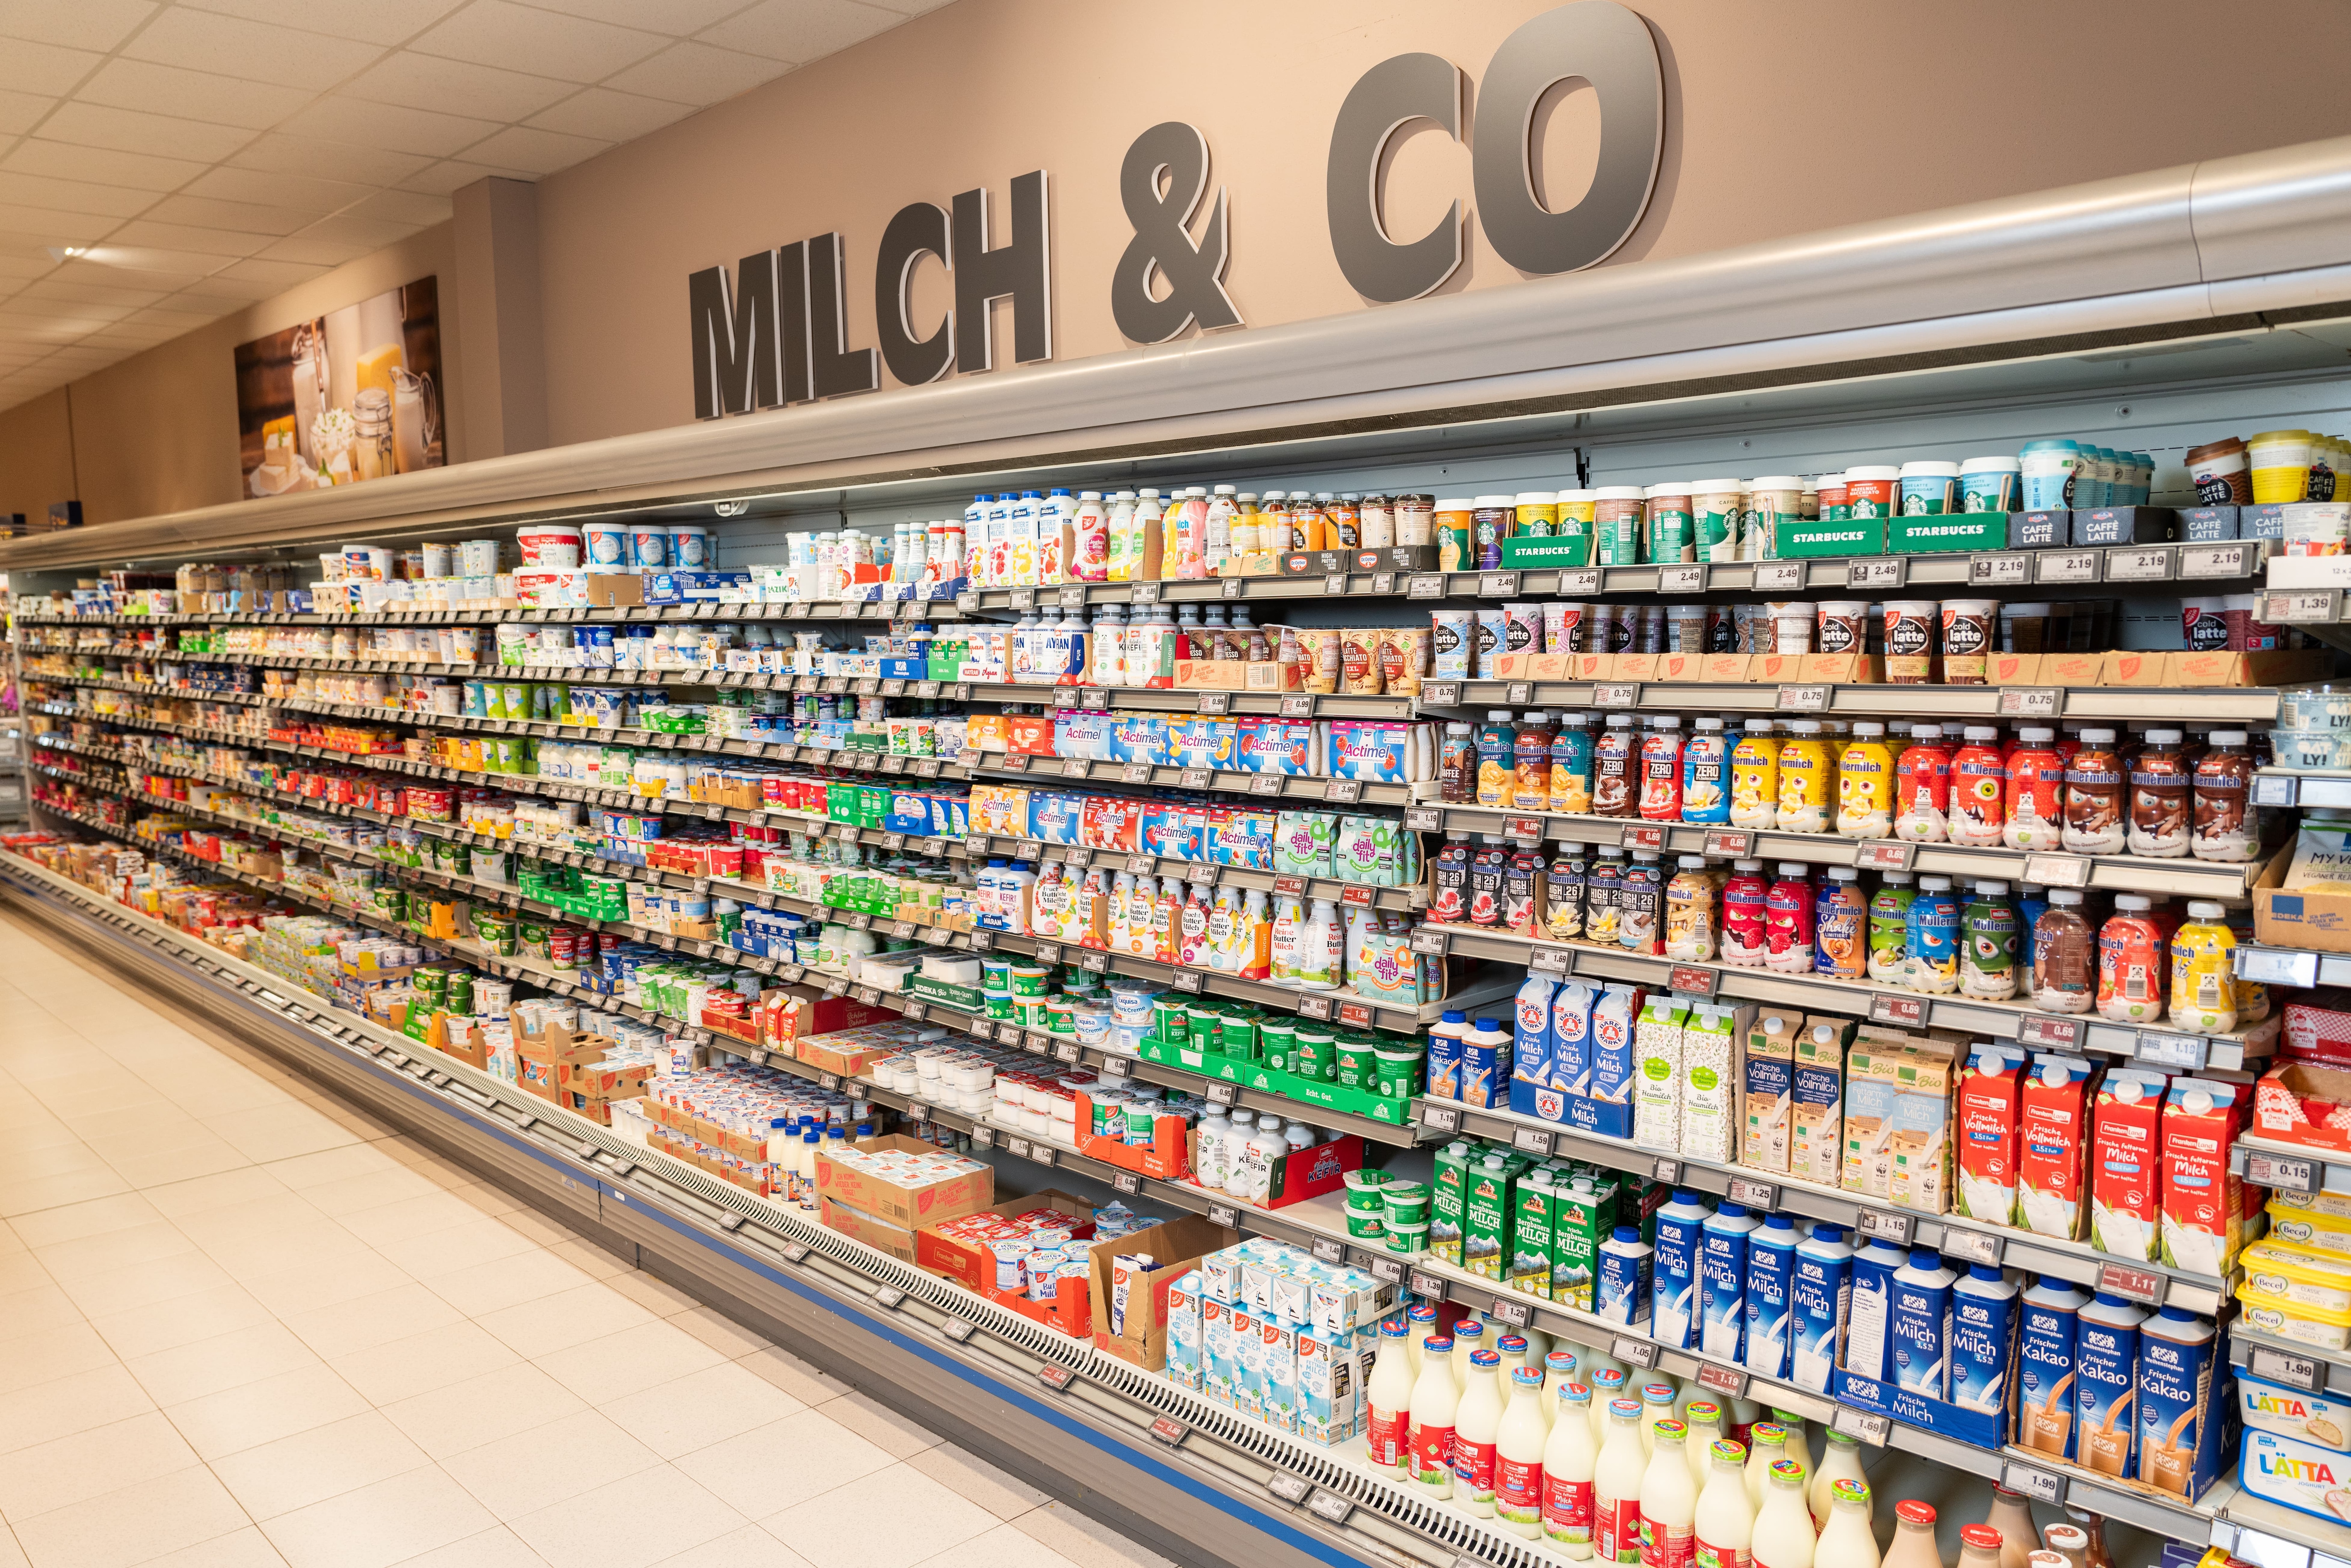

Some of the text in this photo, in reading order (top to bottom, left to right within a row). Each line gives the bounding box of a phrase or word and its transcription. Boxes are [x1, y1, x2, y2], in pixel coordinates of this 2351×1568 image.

[689, 0, 1666, 420] MILCH & CO
[1906, 525, 1984, 536] STARBUCKS
[2022, 523, 2053, 534] CAFFÈ
[2188, 520, 2221, 530] CAFFÈ
[1793, 532, 1864, 542] STARBUCKS
[2023, 534, 2051, 543] LATTE
[2190, 530, 2220, 539] LATTE
[1515, 547, 1571, 556] STARBUCKS
[2212, 554, 2240, 563] 2.19
[1999, 562, 2023, 571] 2.19
[2300, 599, 2328, 609] 1.39
[1436, 635, 1457, 644] latte
[1893, 631, 1925, 642] latte
[2028, 695, 2052, 704] 0.75
[1123, 731, 1161, 744] Actimel
[1344, 745, 1390, 757] Actimel
[1650, 764, 1672, 774] ZERO
[1696, 766, 1719, 776] ZERO
[1425, 813, 1437, 821] 1.19
[1154, 826, 1191, 839] Actimel
[1646, 832, 1661, 842] 0.69
[1291, 833, 1313, 846] daily
[1297, 845, 1308, 855] fit
[1591, 889, 1609, 898] HIGH
[983, 917, 1003, 926] MILRAM
[2272, 913, 2304, 921] EDEKA
[1554, 954, 1566, 963] 1.69
[915, 984, 937, 995] EDEKA
[1117, 996, 1139, 1006] Exquisa
[1355, 1010, 1368, 1018] 1.99
[1520, 1042, 1543, 1056] Milch
[1430, 1054, 1453, 1066] Kakao
[1816, 1052, 1839, 1063] Bio
[1754, 1063, 1780, 1072] Frische
[1749, 1068, 1787, 1082] Vollmilch
[1306, 1089, 1333, 1102] Echt. Gut.
[1641, 1089, 1672, 1100] Heumilch
[1575, 1100, 1595, 1111] Frische
[1440, 1113, 1454, 1123] 1.19
[1572, 1109, 1597, 1125] Milch
[2033, 1123, 2061, 1134] Frische
[1532, 1135, 1547, 1144] 1.59
[2025, 1131, 2071, 1148] Vollmilch
[1145, 1156, 1163, 1165] Fettarmer
[2175, 1161, 2208, 1176] Milch
[2280, 1164, 2308, 1178] 0.15
[947, 1181, 962, 1192] KOMM
[1751, 1187, 1770, 1198] 1.25
[1469, 1205, 1500, 1217] Bergbauern
[1469, 1212, 1500, 1229] MILCH
[1863, 1218, 1904, 1231] BIO 1.15
[1658, 1235, 1685, 1245] Weihenstephan
[1661, 1244, 1680, 1255] Frische
[1655, 1251, 1687, 1269] Milch
[2131, 1276, 2156, 1291] 1.11
[1510, 1307, 1525, 1317] 1.29
[1053, 1316, 1064, 1324] Reine
[1047, 1321, 1068, 1334] Buttermilch
[2083, 1342, 2121, 1356] Weihenstephan
[2086, 1353, 2116, 1367] Frischer
[2078, 1360, 2127, 1386] Kakao
[2284, 1361, 2312, 1376] 1.99
[1840, 1391, 1886, 1410] Weihenstephan
[1898, 1393, 1925, 1407] Frische
[1893, 1400, 1933, 1424] Milch
[1167, 1424, 1181, 1434] 0.88
[1859, 1418, 1879, 1432] 1.69
[2260, 1453, 2336, 1484] LÄTTA
[2032, 1475, 2055, 1490] 1.99
